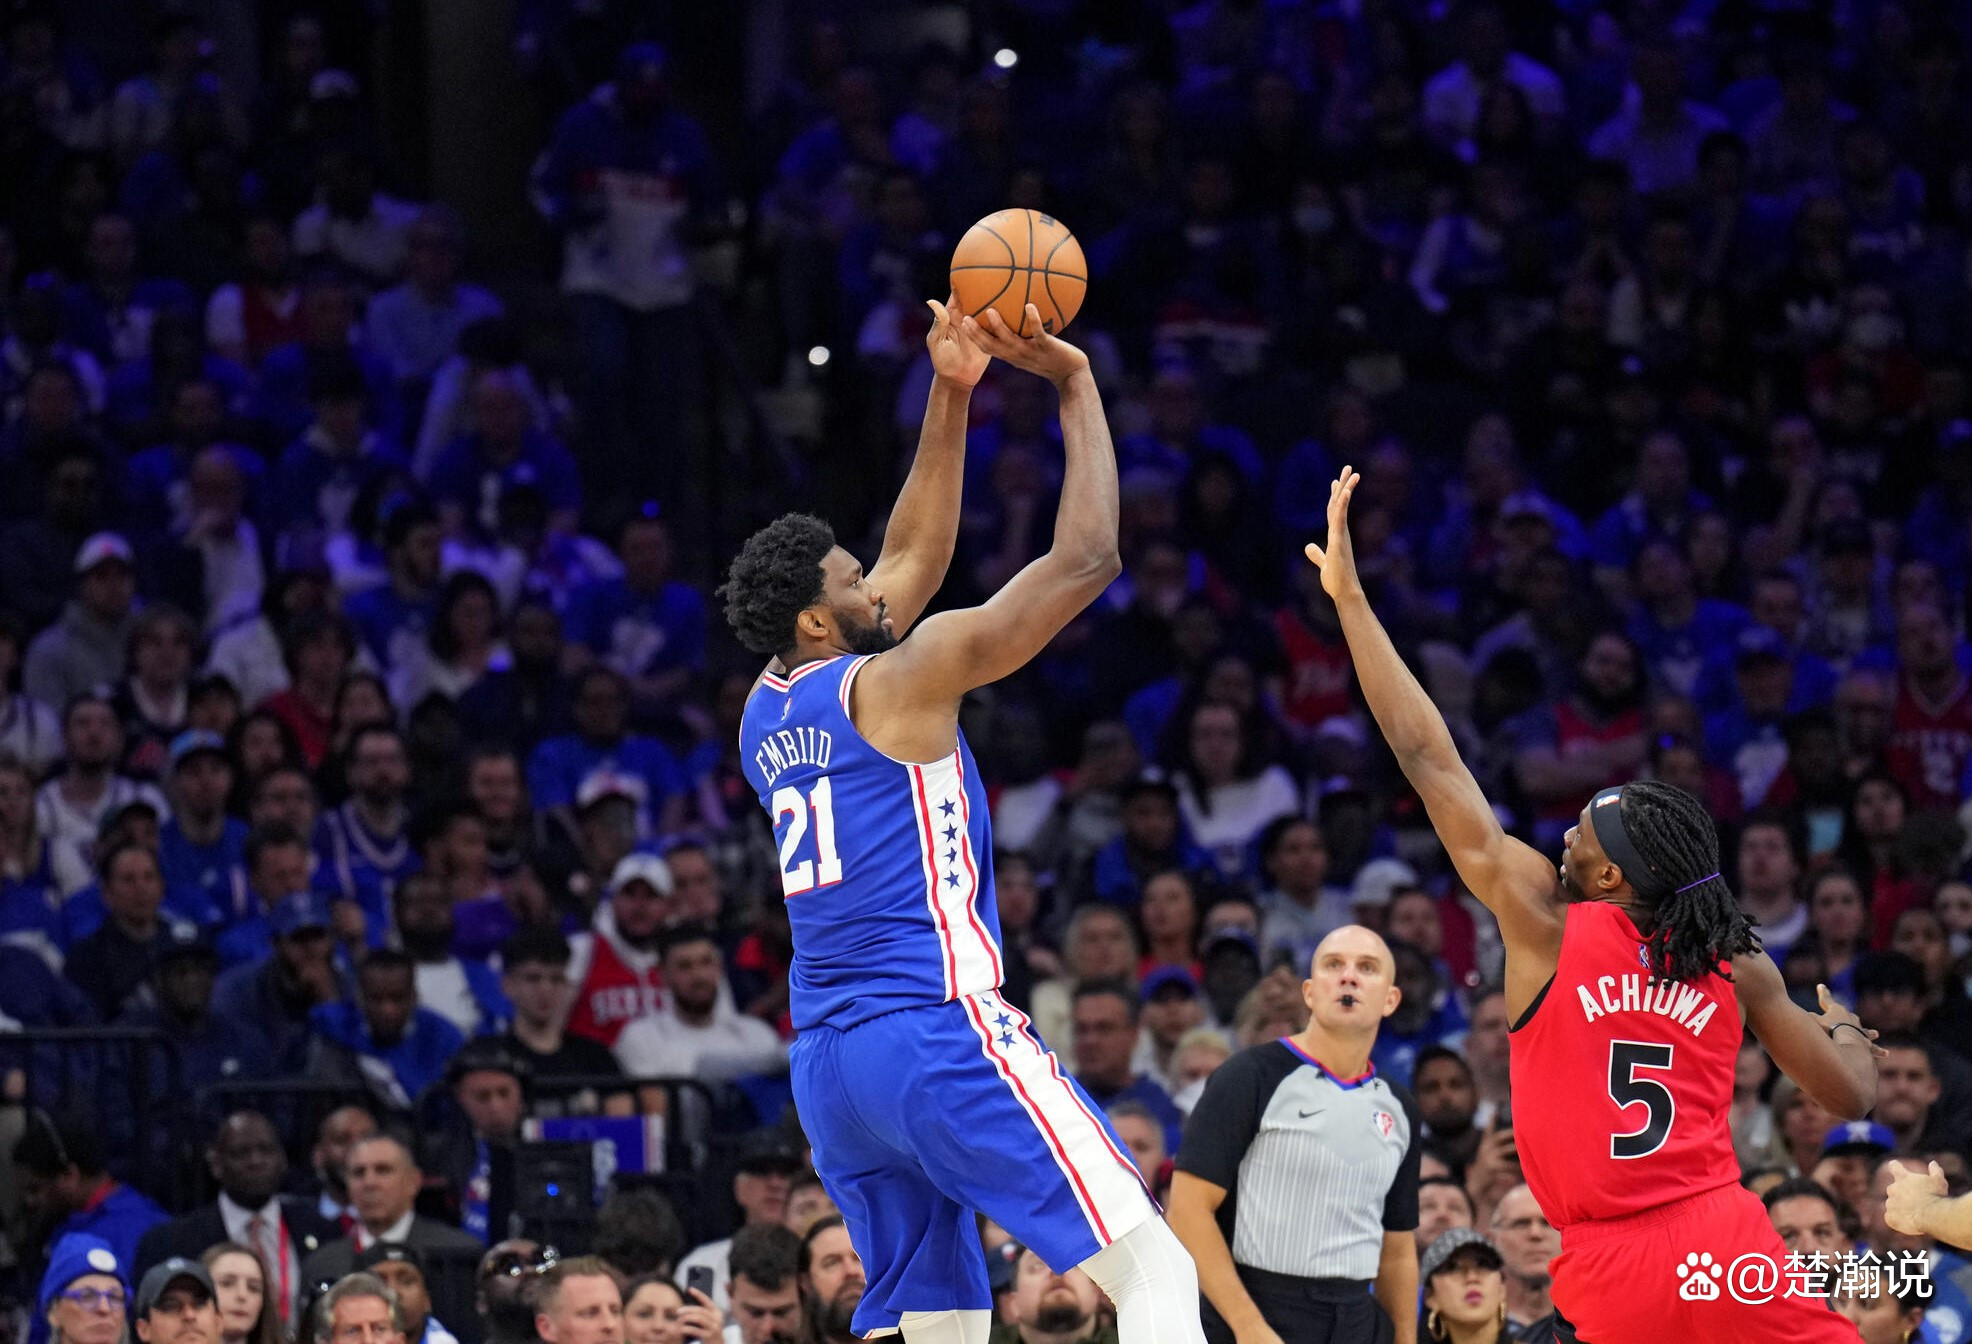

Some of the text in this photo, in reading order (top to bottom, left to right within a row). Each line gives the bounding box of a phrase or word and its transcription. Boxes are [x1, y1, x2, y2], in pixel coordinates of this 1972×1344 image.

[756, 727, 832, 787] EMBIID
[772, 775, 842, 898] 21
[1576, 973, 1718, 1037] ACHIUWA
[1607, 1039, 1675, 1159] 5
